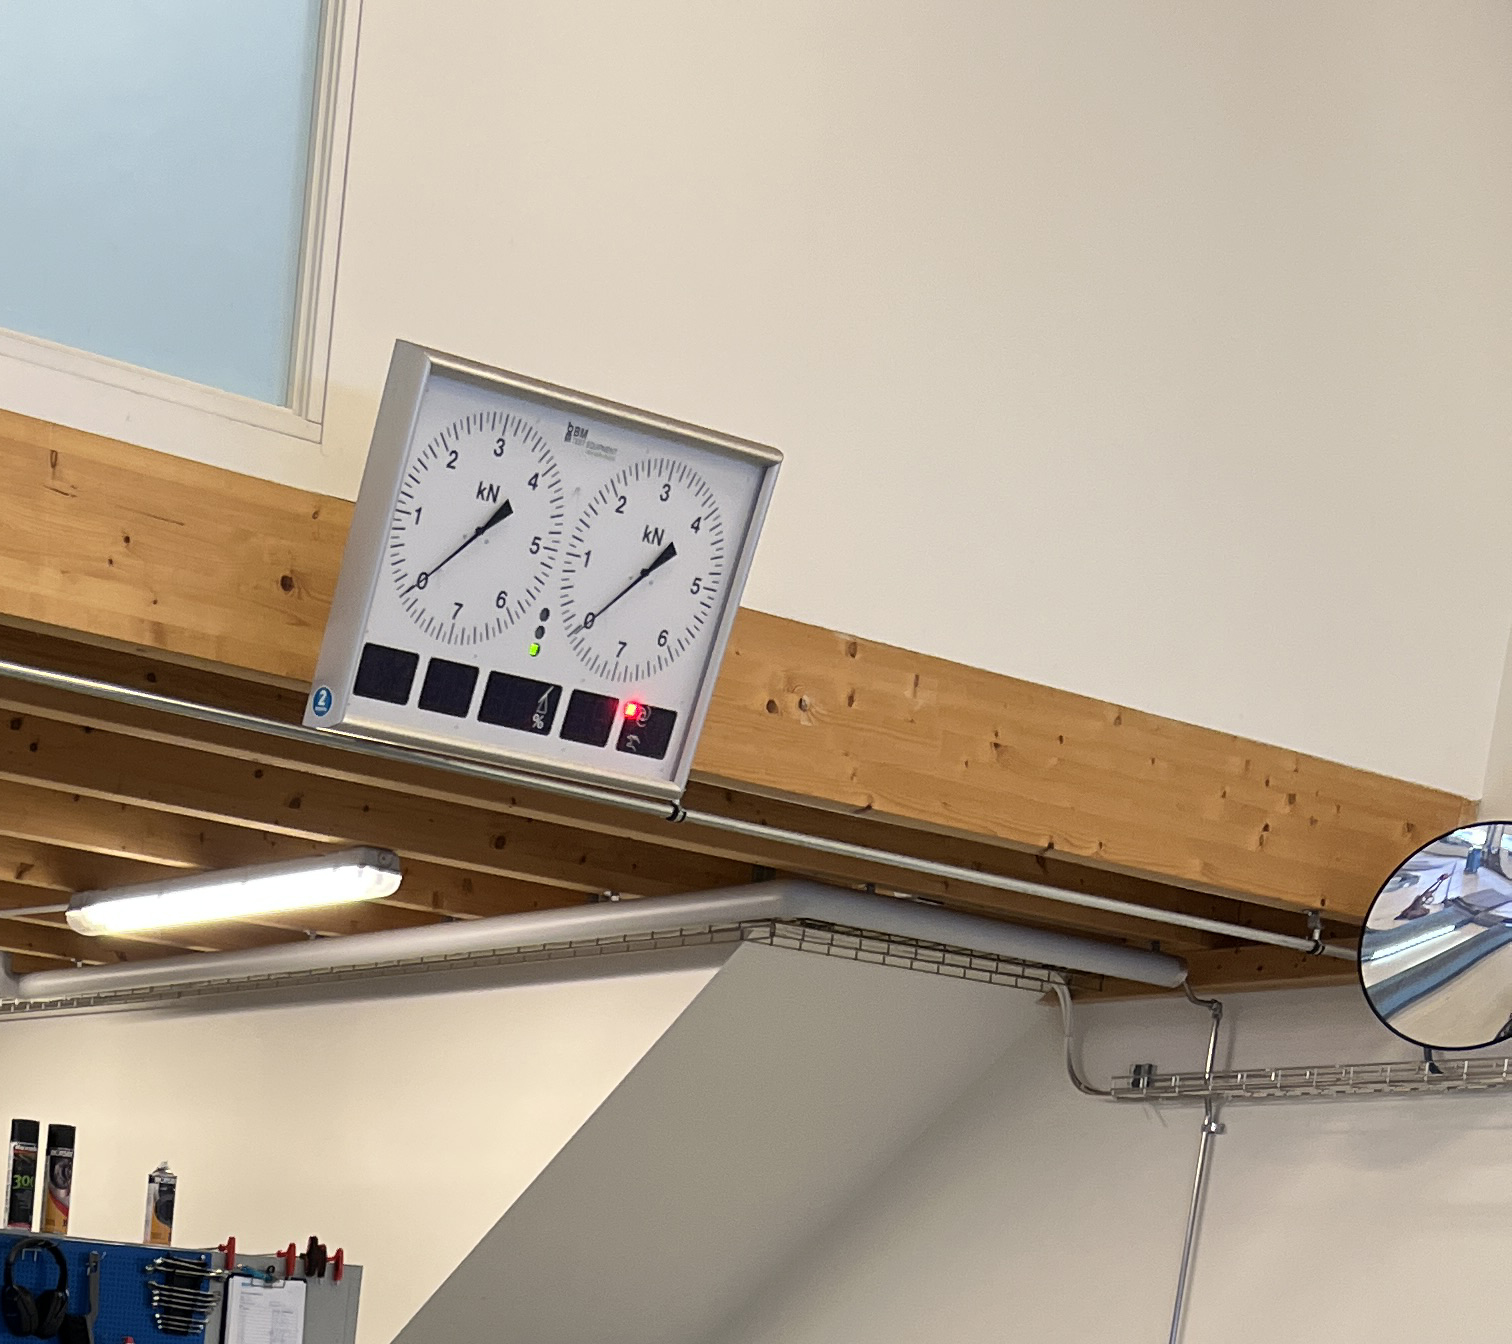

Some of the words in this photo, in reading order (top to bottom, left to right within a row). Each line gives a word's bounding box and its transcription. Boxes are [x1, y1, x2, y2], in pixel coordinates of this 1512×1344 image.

[494, 438, 506, 457] 3
[446, 450, 459, 469] 2
[528, 472, 540, 491] 4
[475, 480, 501, 504] kN
[659, 483, 671, 502] 3
[615, 495, 627, 514] 2
[414, 507, 423, 525] 1
[690, 516, 702, 534] 4
[641, 524, 665, 546] kN
[529, 536, 542, 555] 5
[584, 550, 592, 568] 1
[417, 572, 429, 590] 0
[690, 577, 702, 595] 5
[495, 590, 508, 609] 6
[452, 601, 464, 620] 7
[584, 612, 595, 629] 0
[657, 629, 669, 647] 6
[616, 640, 628, 658] 7
[317, 689, 328, 706] 2
